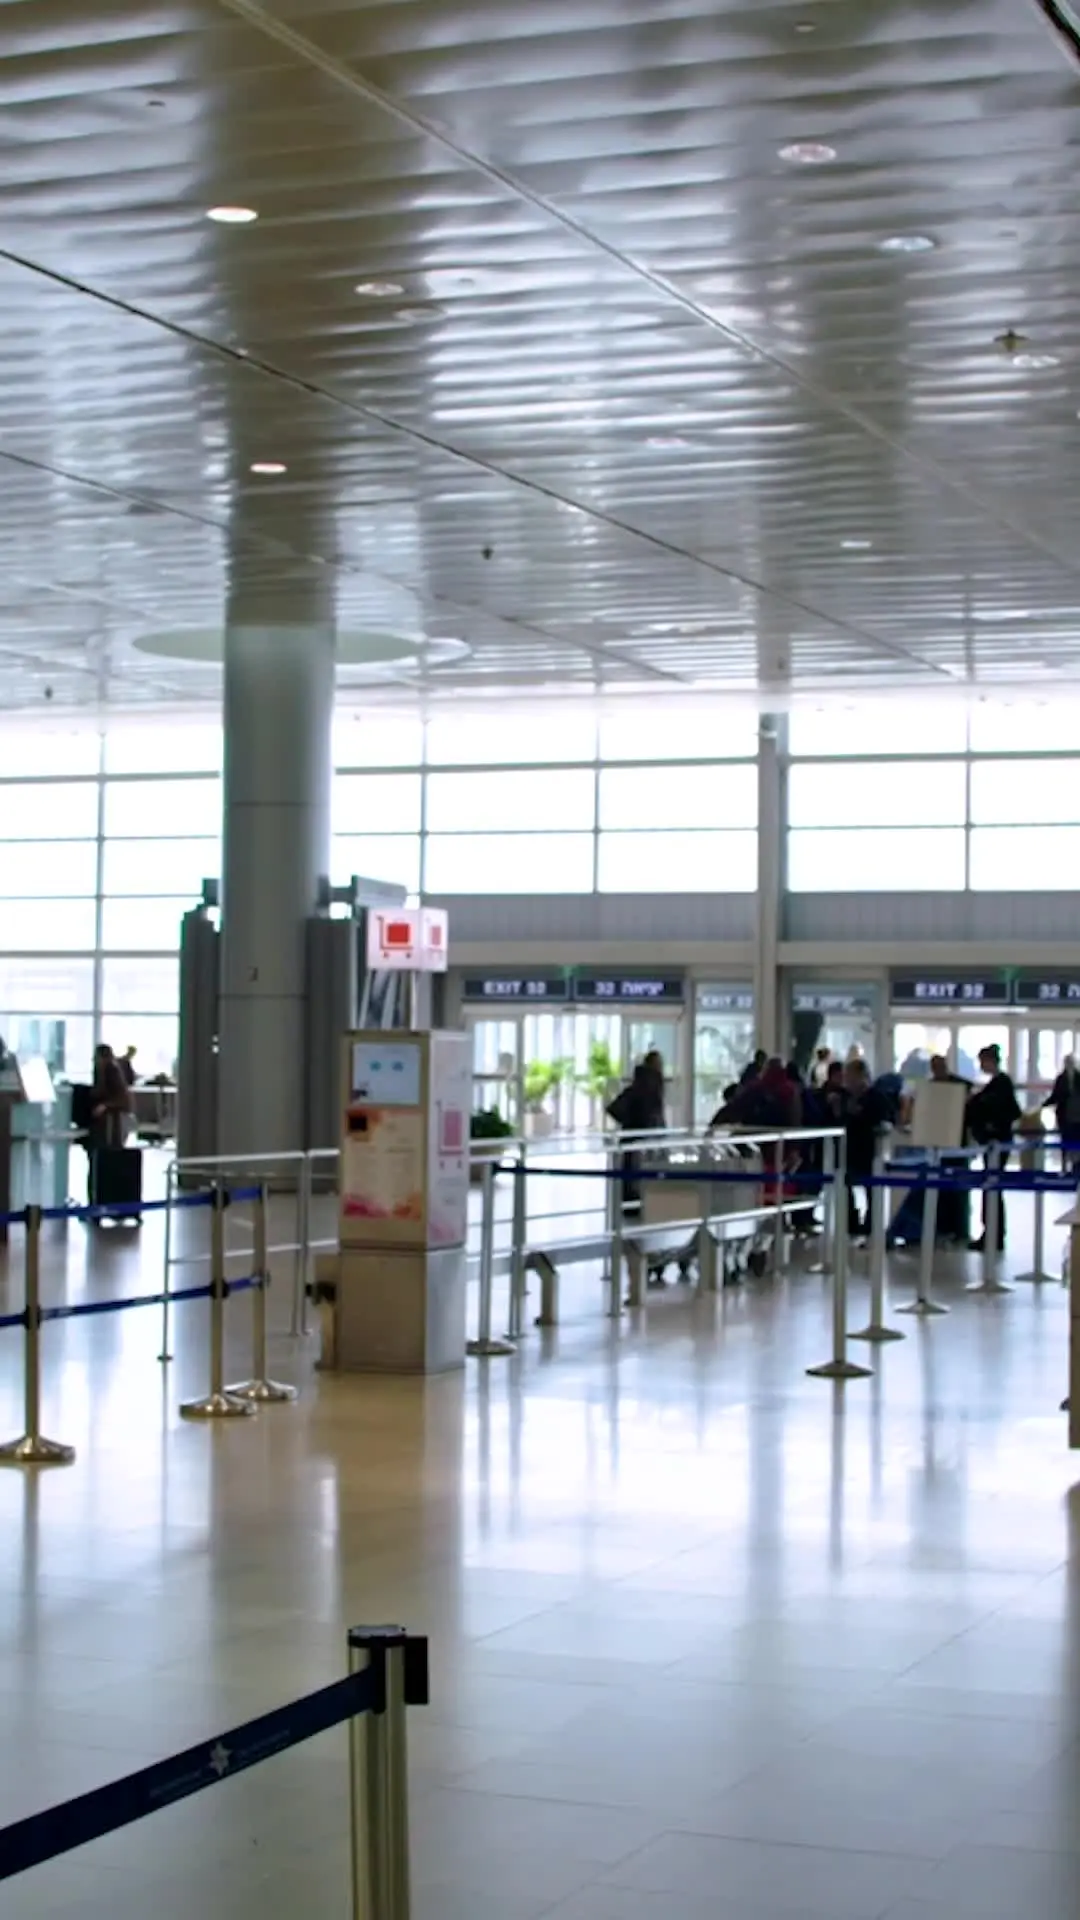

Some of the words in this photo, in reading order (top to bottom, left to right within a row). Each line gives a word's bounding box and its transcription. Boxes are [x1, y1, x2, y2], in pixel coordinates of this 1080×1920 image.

[484, 981, 521, 995] EXIT
[915, 983, 957, 998] EXIT
[963, 983, 985, 999] 32
[1038, 983, 1061, 998] 32
